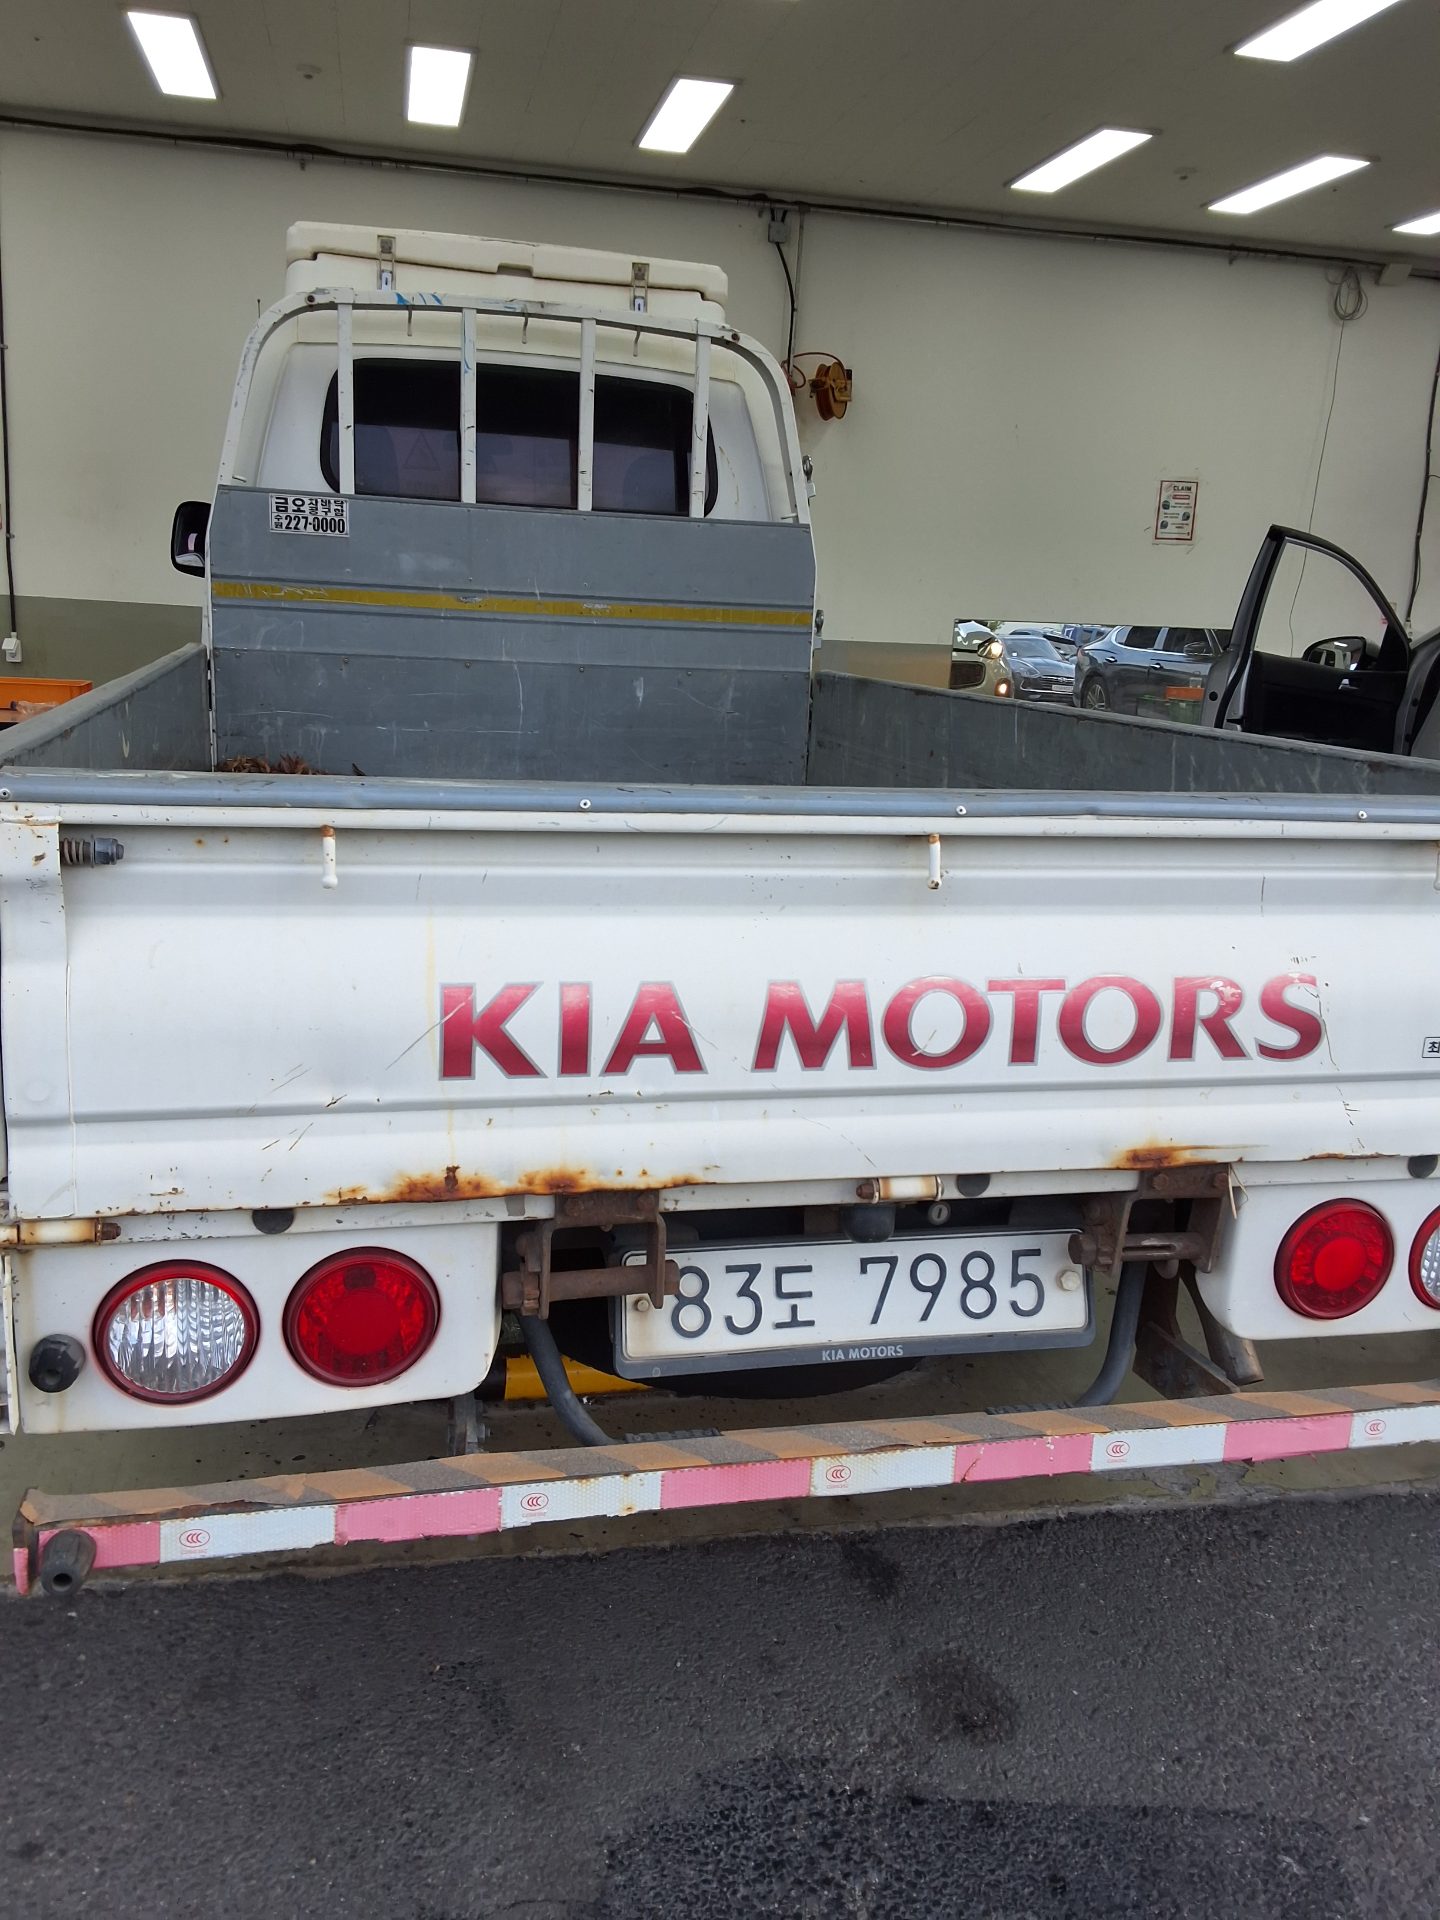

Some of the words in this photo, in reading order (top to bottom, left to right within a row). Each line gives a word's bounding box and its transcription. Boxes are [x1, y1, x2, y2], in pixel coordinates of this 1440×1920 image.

[274, 496, 306, 513] 금오
[284, 514, 346, 534] 227-0000
[438, 980, 710, 1081] KIA
[751, 972, 1325, 1072] MOTORS
[670, 1263, 816, 1339] 83도
[859, 1247, 1046, 1325] 7985
[821, 1348, 846, 1361] KIA
[848, 1344, 904, 1360] MOTORS
